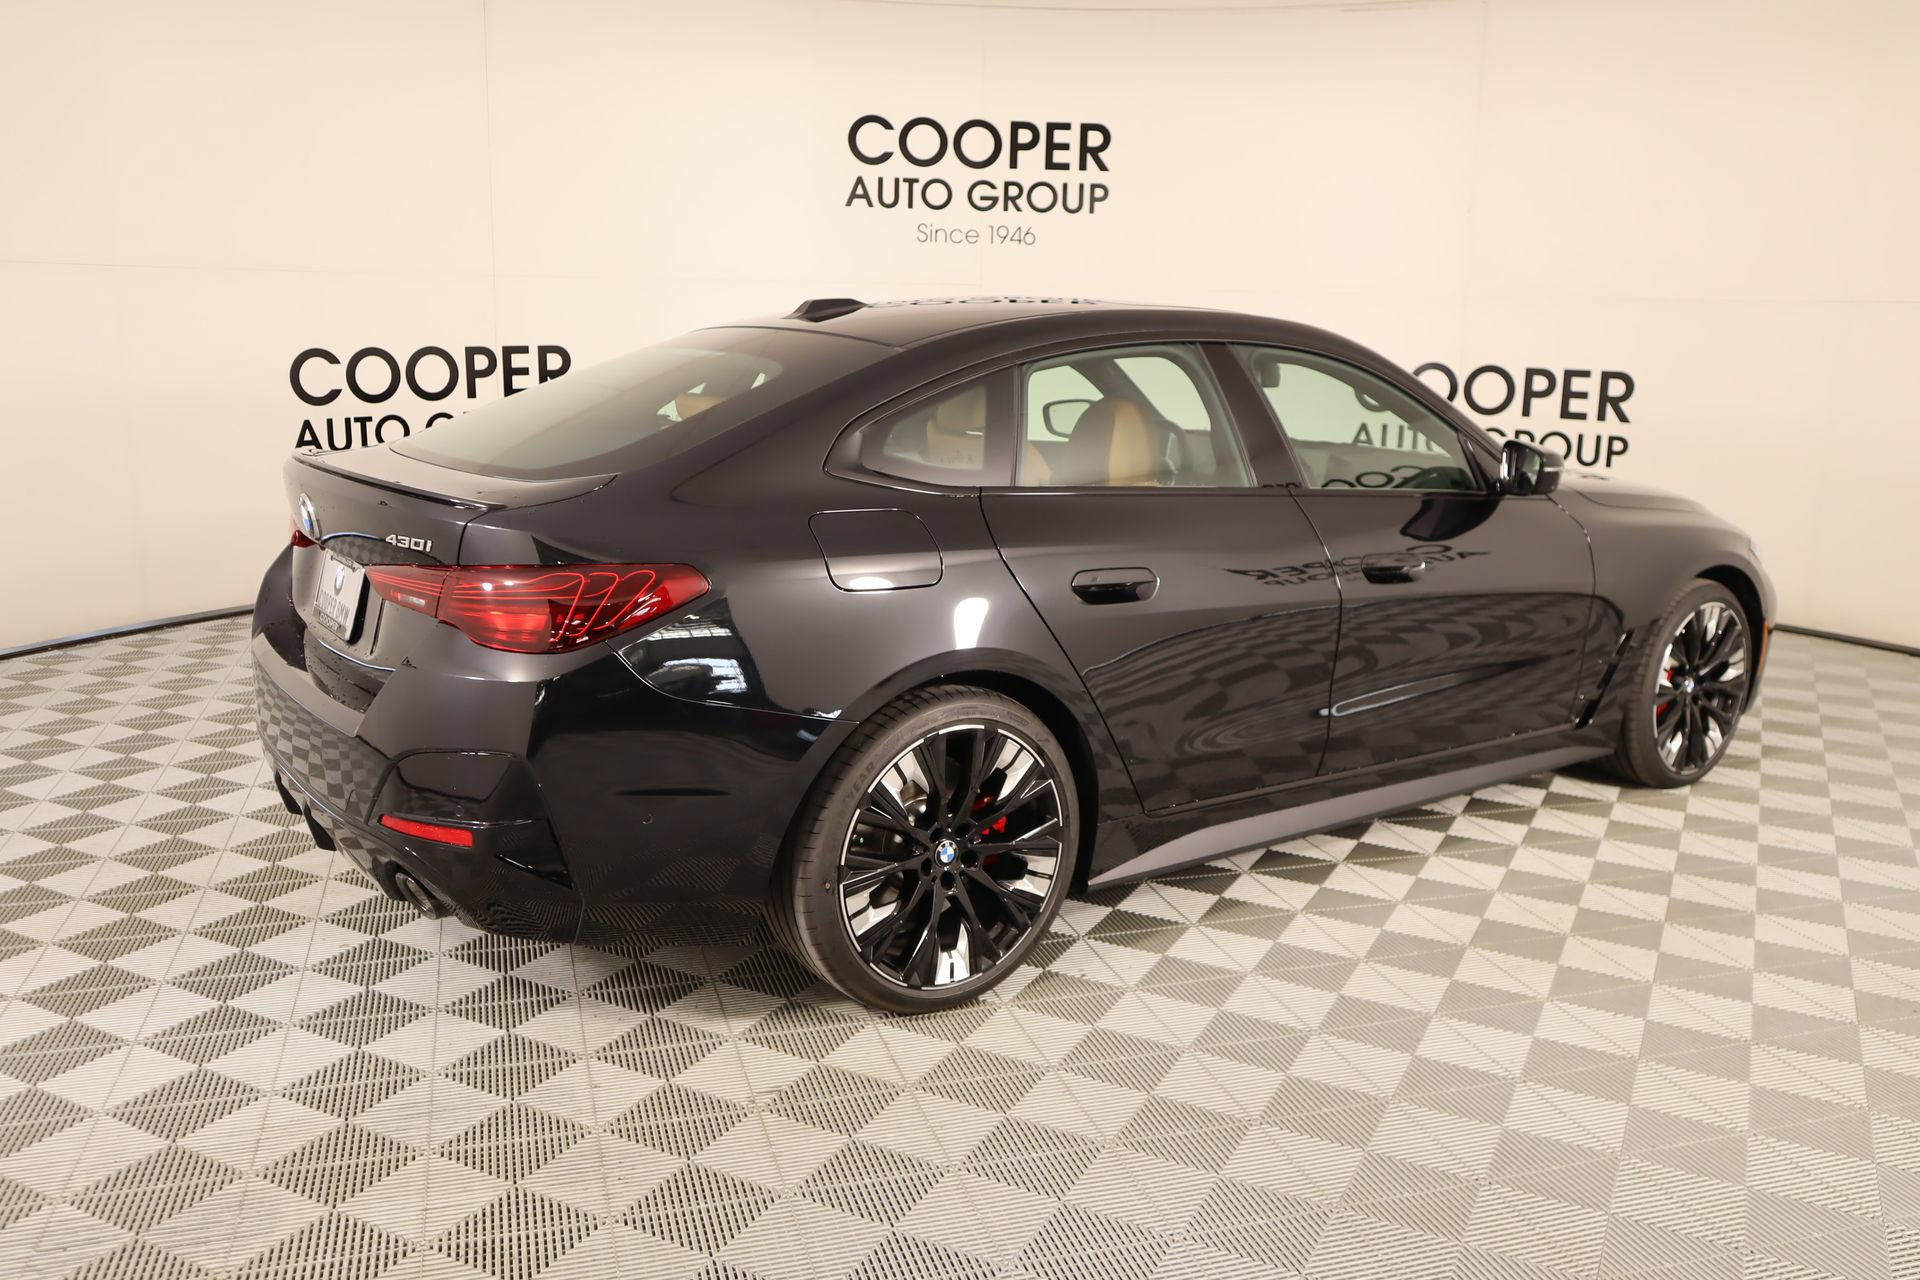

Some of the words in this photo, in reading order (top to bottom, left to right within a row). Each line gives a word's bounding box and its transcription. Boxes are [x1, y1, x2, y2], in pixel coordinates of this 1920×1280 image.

[847, 114, 1112, 171] COOPER
[845, 176, 952, 210] AUTO
[967, 180, 1109, 214] GROUP
[916, 223, 980, 244] Since
[988, 225, 1036, 245] 1946
[385, 534, 432, 552] 430i
